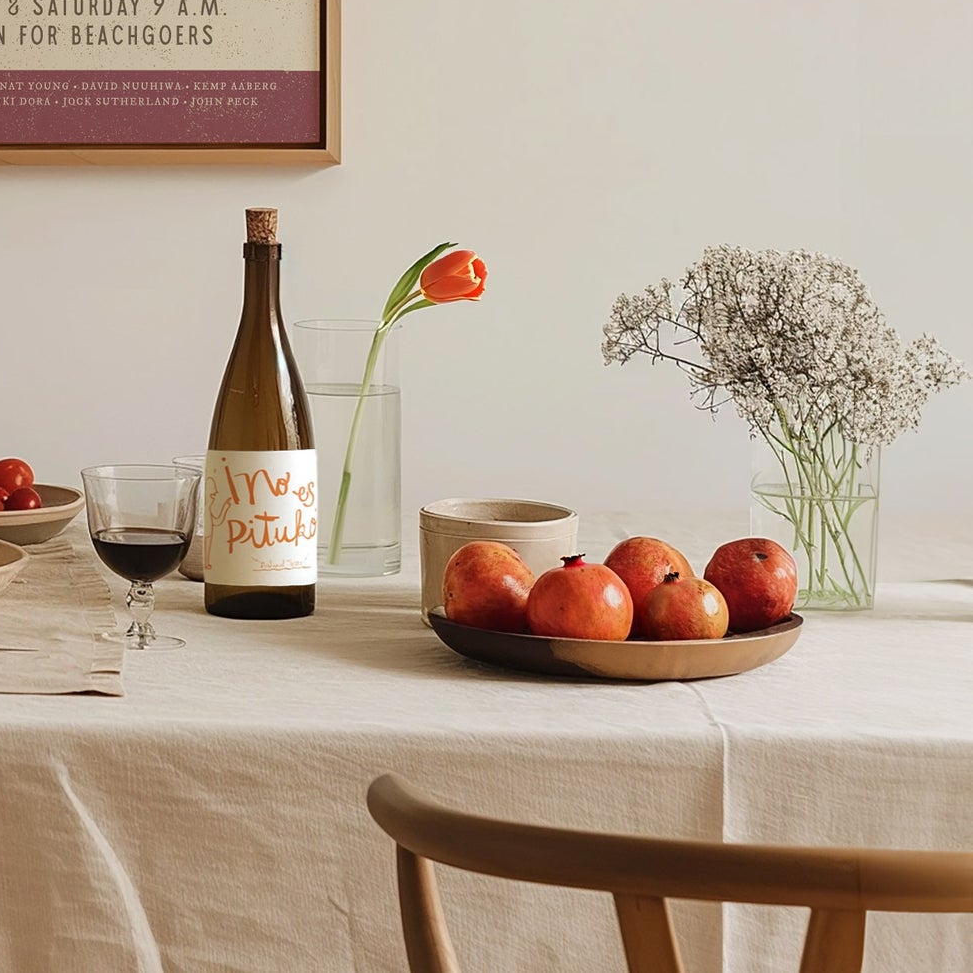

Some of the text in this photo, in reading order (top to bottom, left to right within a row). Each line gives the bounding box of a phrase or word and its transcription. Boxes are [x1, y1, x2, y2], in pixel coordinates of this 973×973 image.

[19, 25, 58, 45] FOR
[71, 25, 214, 45] BEACHGOERS
[0, 81, 24, 91] NAT
[28, 81, 69, 91] YOUNG
[81, 81, 118, 91] DAVID
[122, 81, 182, 91] NUUHIWA
[193, 81, 227, 91] KEMP
[230, 81, 278, 91] AABERG
[20, 96, 52, 106] DORA
[61, 96, 92, 107] JOCK
[96, 96, 179, 106] SUTHERLAND
[189, 96, 223, 107] JOHN
[227, 96, 258, 106] PECK
